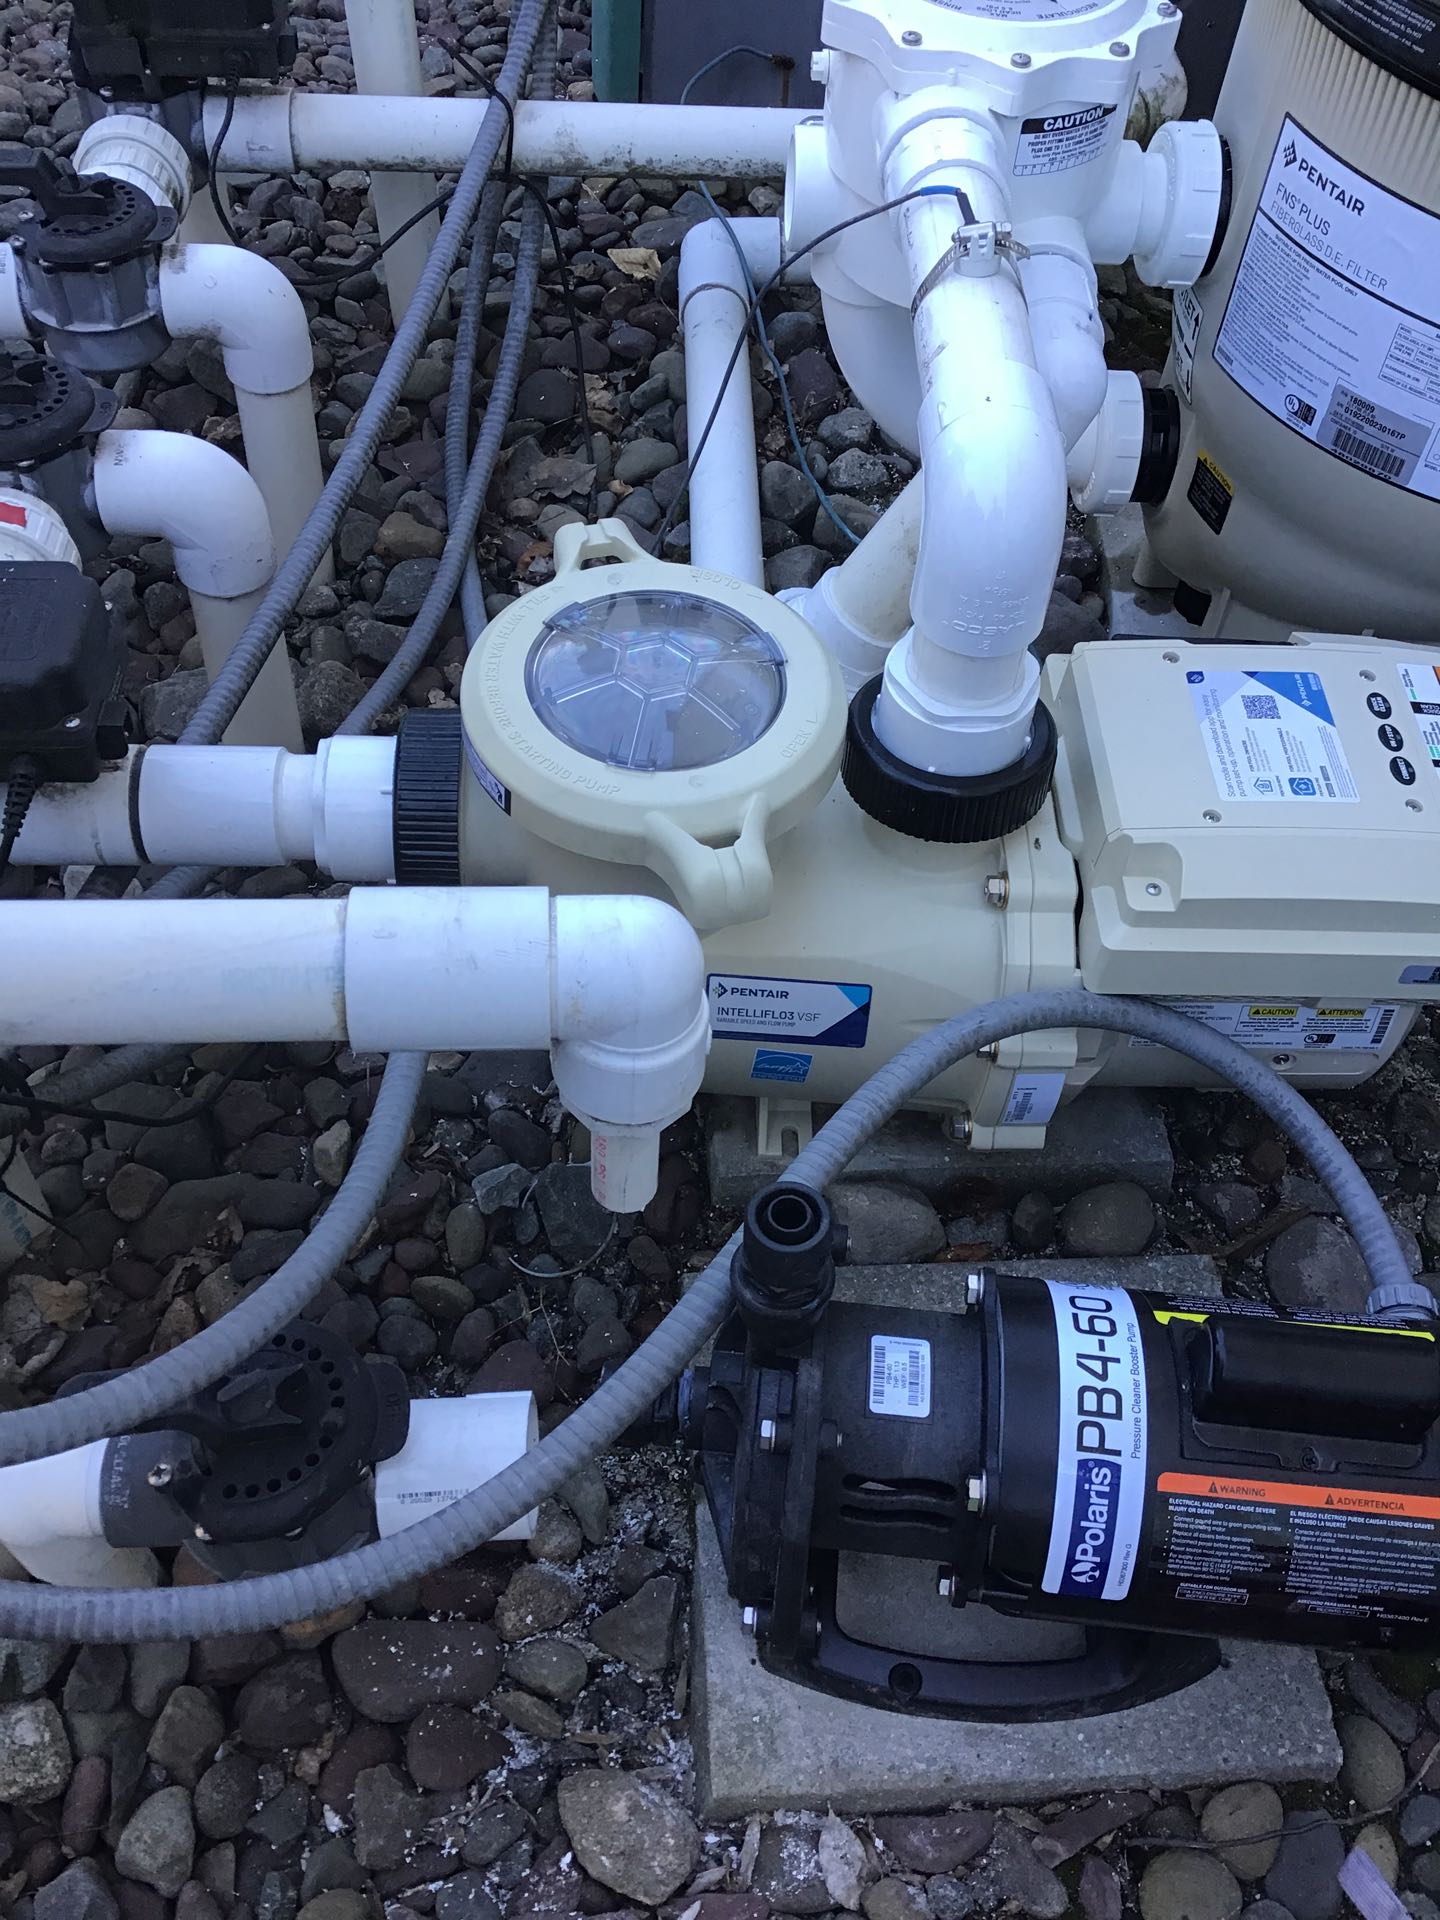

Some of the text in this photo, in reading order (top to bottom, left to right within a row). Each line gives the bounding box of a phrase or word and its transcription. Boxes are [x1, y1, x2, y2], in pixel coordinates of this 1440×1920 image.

[1036, 2, 1097, 19] RECIRCULATE
[1042, 106, 1106, 132] CAUTION
[1051, 126, 1080, 137] OVERTIGHTEN
[1071, 137, 1085, 146] TURNS
[1298, 158, 1365, 216] PENTAIR
[1299, 203, 1331, 236] PLUS
[1270, 201, 1388, 291] FIBERGLASS D.E. FILTER
[1273, 233, 1358, 297] SUITABLE FOR FRESH WATER POOL ONLY
[1295, 260, 1310, 274] FILTER
[1347, 393, 1376, 413] 180009
[1342, 406, 1406, 441] 0192200230167P
[1207, 460, 1234, 491] CAUTION
[518, 591, 552, 611] FILL
[498, 612, 526, 642] WITH
[485, 642, 506, 682] WATER
[1294, 672, 1308, 699] PENTAIR
[487, 685, 514, 732] BEFORE
[1376, 696, 1385, 712] CLEAN
[781, 730, 808, 759] OPEN
[1200, 693, 1234, 797] Scan code and download app for easy
[1209, 687, 1245, 797] pump set-up, operation and monitoring
[508, 731, 572, 781] STARTING
[1396, 757, 1409, 779] CONNECT
[572, 773, 622, 796] PUMP
[731, 987, 790, 1000] PENTAIR
[717, 1006, 821, 1022] INTELLIFLO3 VSF
[1067, 1294, 1123, 1457] PB4-60
[1125, 1321, 1142, 1459] Pressure Cleaner Booster Pump
[1219, 1484, 1266, 1498] WARNING
[1168, 1497, 1201, 1507] ELECTRICAL
[1201, 1501, 1224, 1509] HAZARD
[1236, 1504, 1254, 1512] CAUSE
[1254, 1506, 1276, 1514] SEVERE
[1196, 1507, 1214, 1515] DEATH
[1336, 1495, 1405, 1512] ADVERTENCIA
[1297, 1511, 1317, 1519] RIESGO
[1365, 1517, 1387, 1525] CAUSAR
[1387, 1519, 1413, 1528] LESIONES
[1413, 1522, 1435, 1530] GRAVES
[1122, 1550, 1131, 1561] Rev
